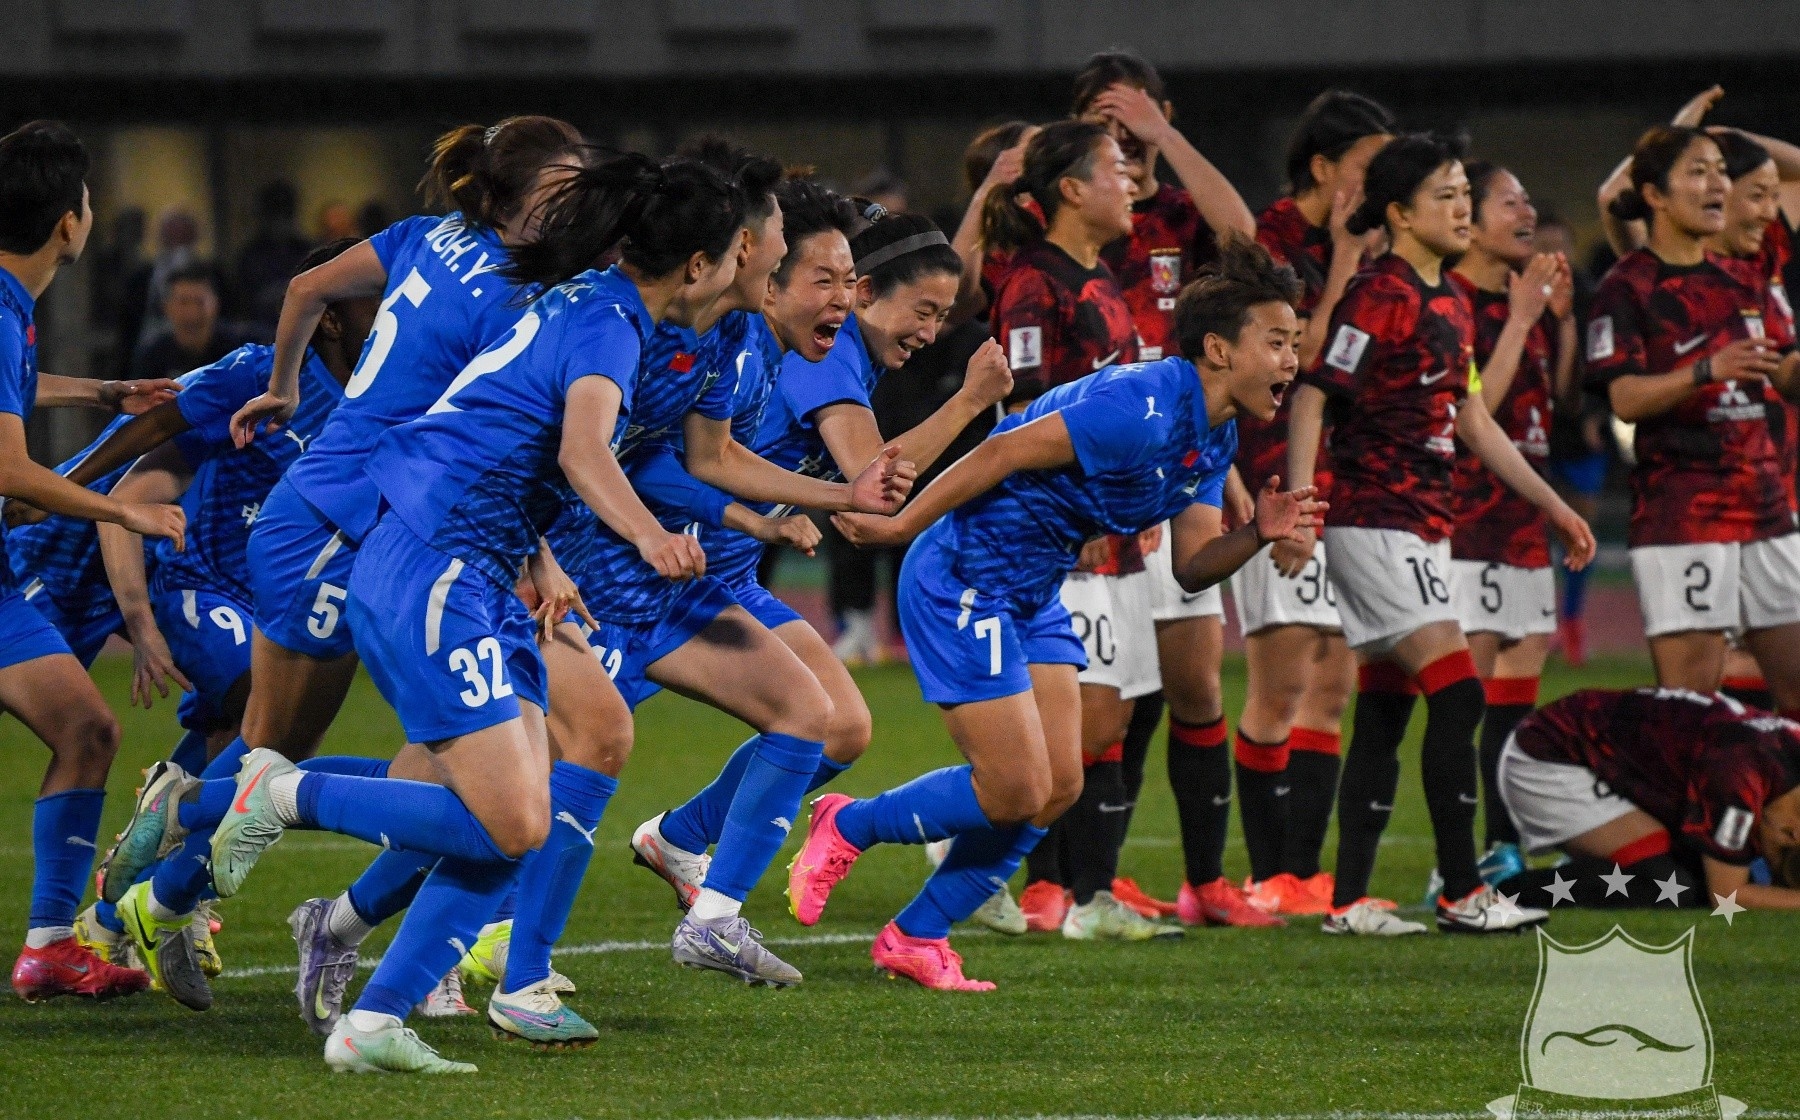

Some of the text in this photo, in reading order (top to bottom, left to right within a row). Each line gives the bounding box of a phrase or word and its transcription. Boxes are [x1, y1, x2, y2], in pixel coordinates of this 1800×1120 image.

[344, 266, 432, 398] 5
[307, 582, 347, 639] 5
[1480, 562, 1502, 613] 5
[1685, 561, 1711, 611] 2
[209, 606, 246, 645] 9
[974, 616, 1001, 676] 7
[449, 637, 513, 708] 32
